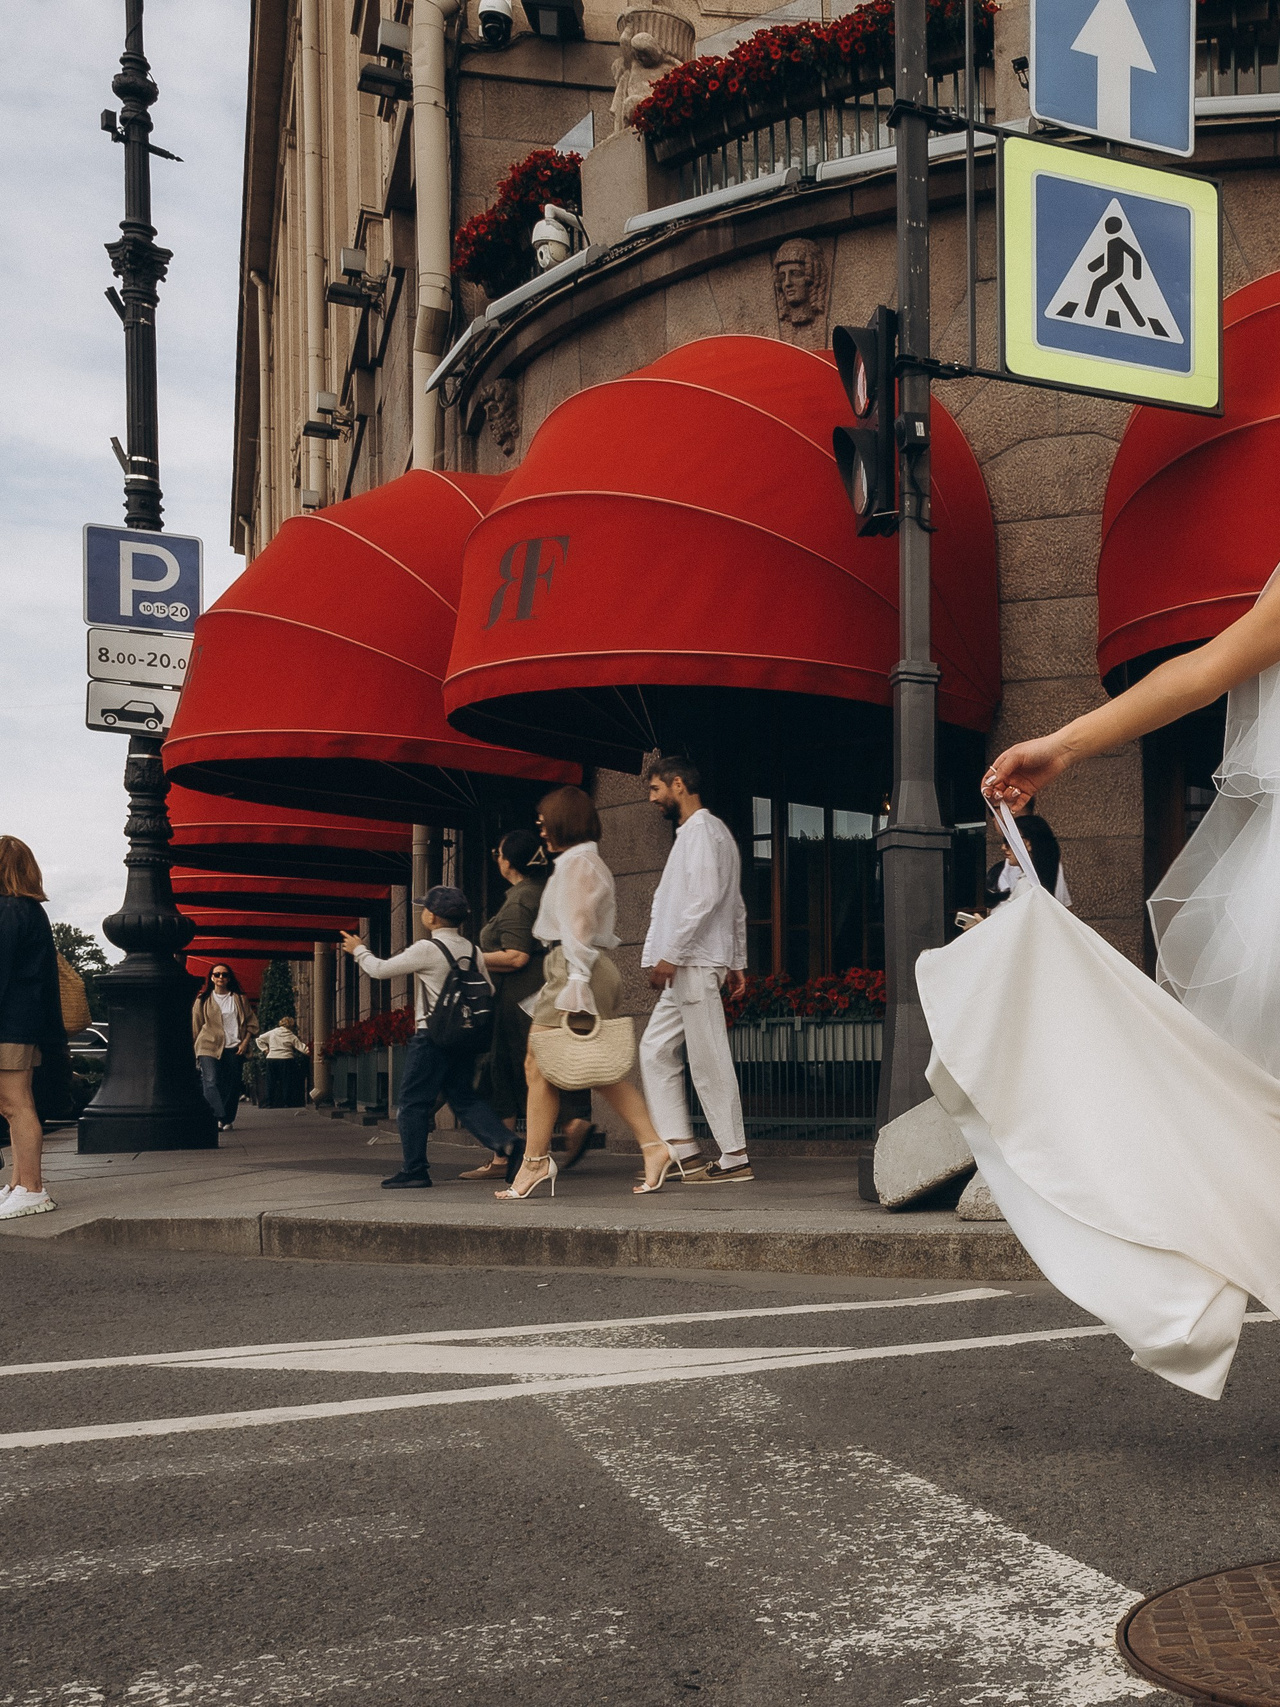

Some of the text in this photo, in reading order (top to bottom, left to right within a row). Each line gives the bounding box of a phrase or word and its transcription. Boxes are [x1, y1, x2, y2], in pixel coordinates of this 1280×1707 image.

[119, 540, 181, 617] P
[142, 603, 188, 618] 10 15 20
[97, 647, 187, 670] 8.00-20.0
